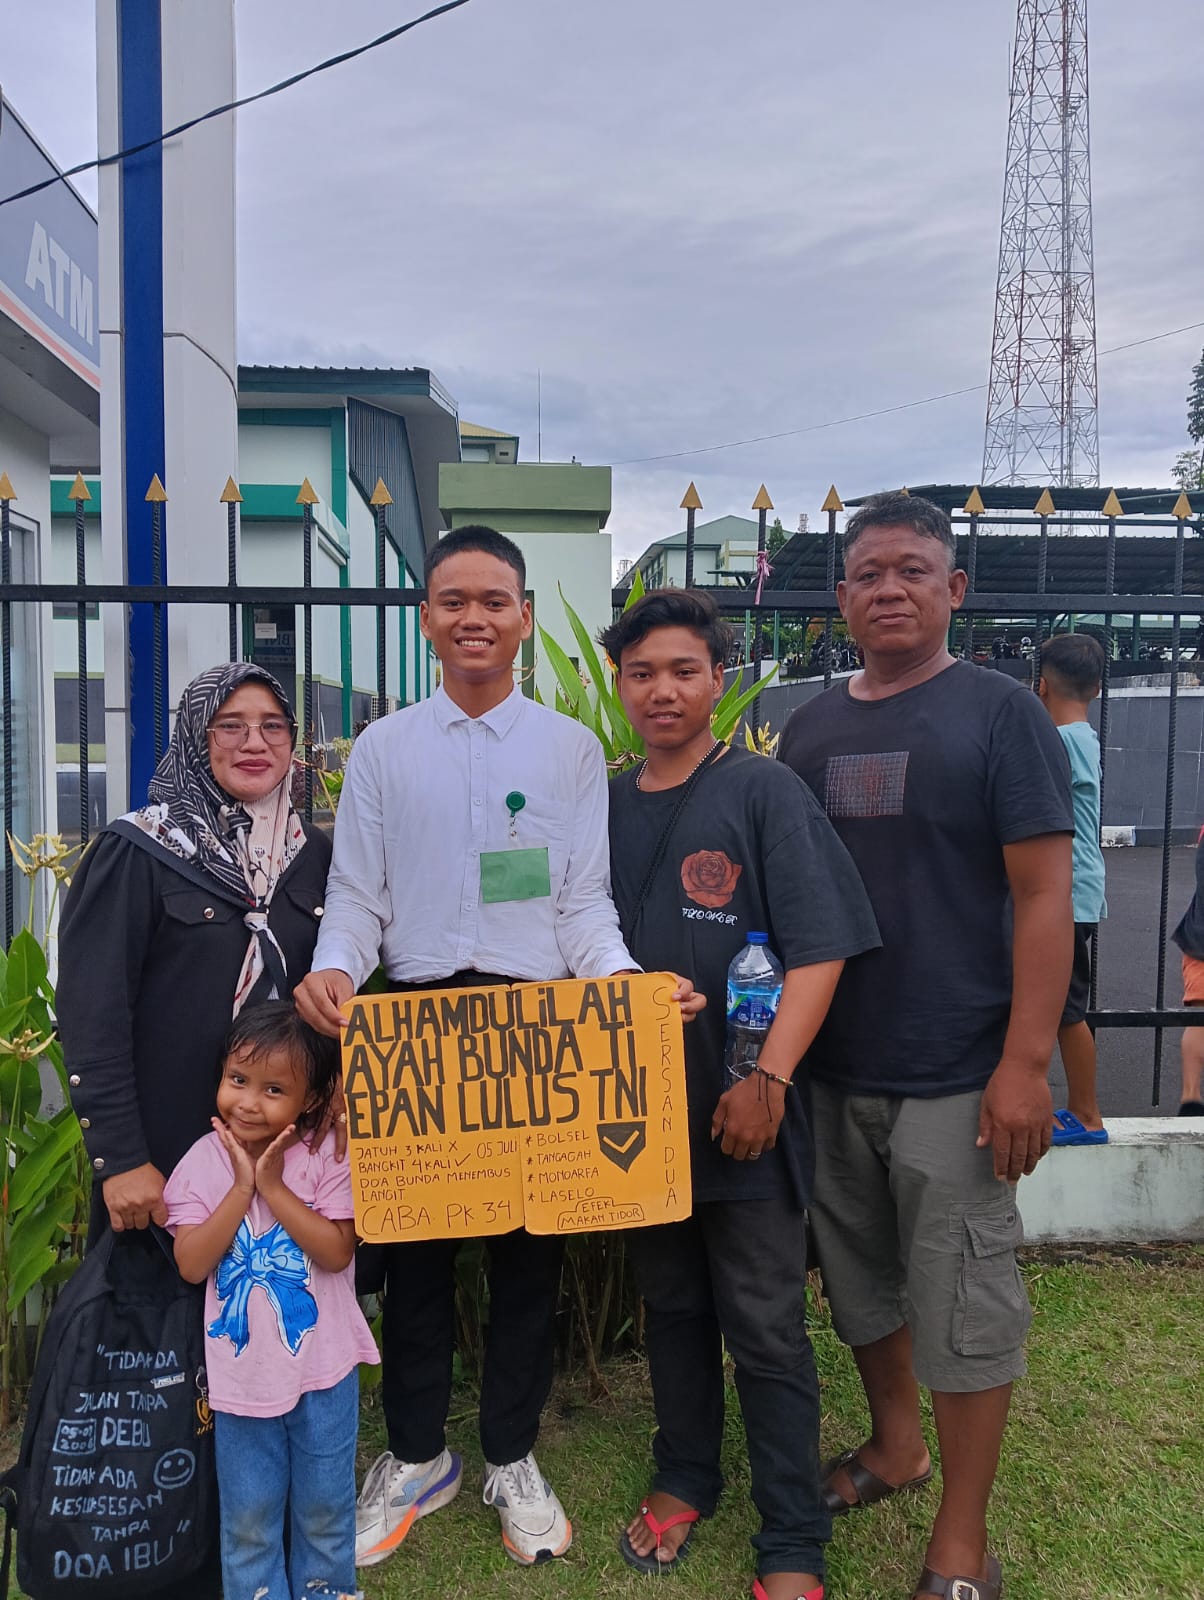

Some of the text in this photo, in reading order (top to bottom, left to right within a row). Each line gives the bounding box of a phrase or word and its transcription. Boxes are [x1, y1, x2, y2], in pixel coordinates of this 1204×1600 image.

[25, 220, 93, 346] ATM
[345, 1034, 446, 1094] AYAH
[458, 1024, 583, 1082] BUNDA
[347, 1065, 648, 1139] EPAN LULUS TNI
[537, 1130, 590, 1147] BOLSEL
[355, 1146, 397, 1160] JATUH
[405, 1145, 412, 1157] 3
[476, 1142, 493, 1159] 05
[358, 1159, 405, 1174] BANGKIT
[412, 1158, 423, 1173] 4
[538, 1166, 599, 1184] MONOARFA
[396, 1174, 440, 1187] BUNDA
[447, 1168, 511, 1184] MENEMBUS
[361, 1188, 406, 1202] LANGIT
[541, 1187, 594, 1202] LASELO
[362, 1205, 431, 1235] CABA
[482, 1200, 512, 1223] 34
[560, 1207, 640, 1228] MAKAN TIDOR
[100, 1416, 151, 1447] DEBU
[99, 1466, 138, 1489] ADA
[54, 1550, 113, 1579] DOA
